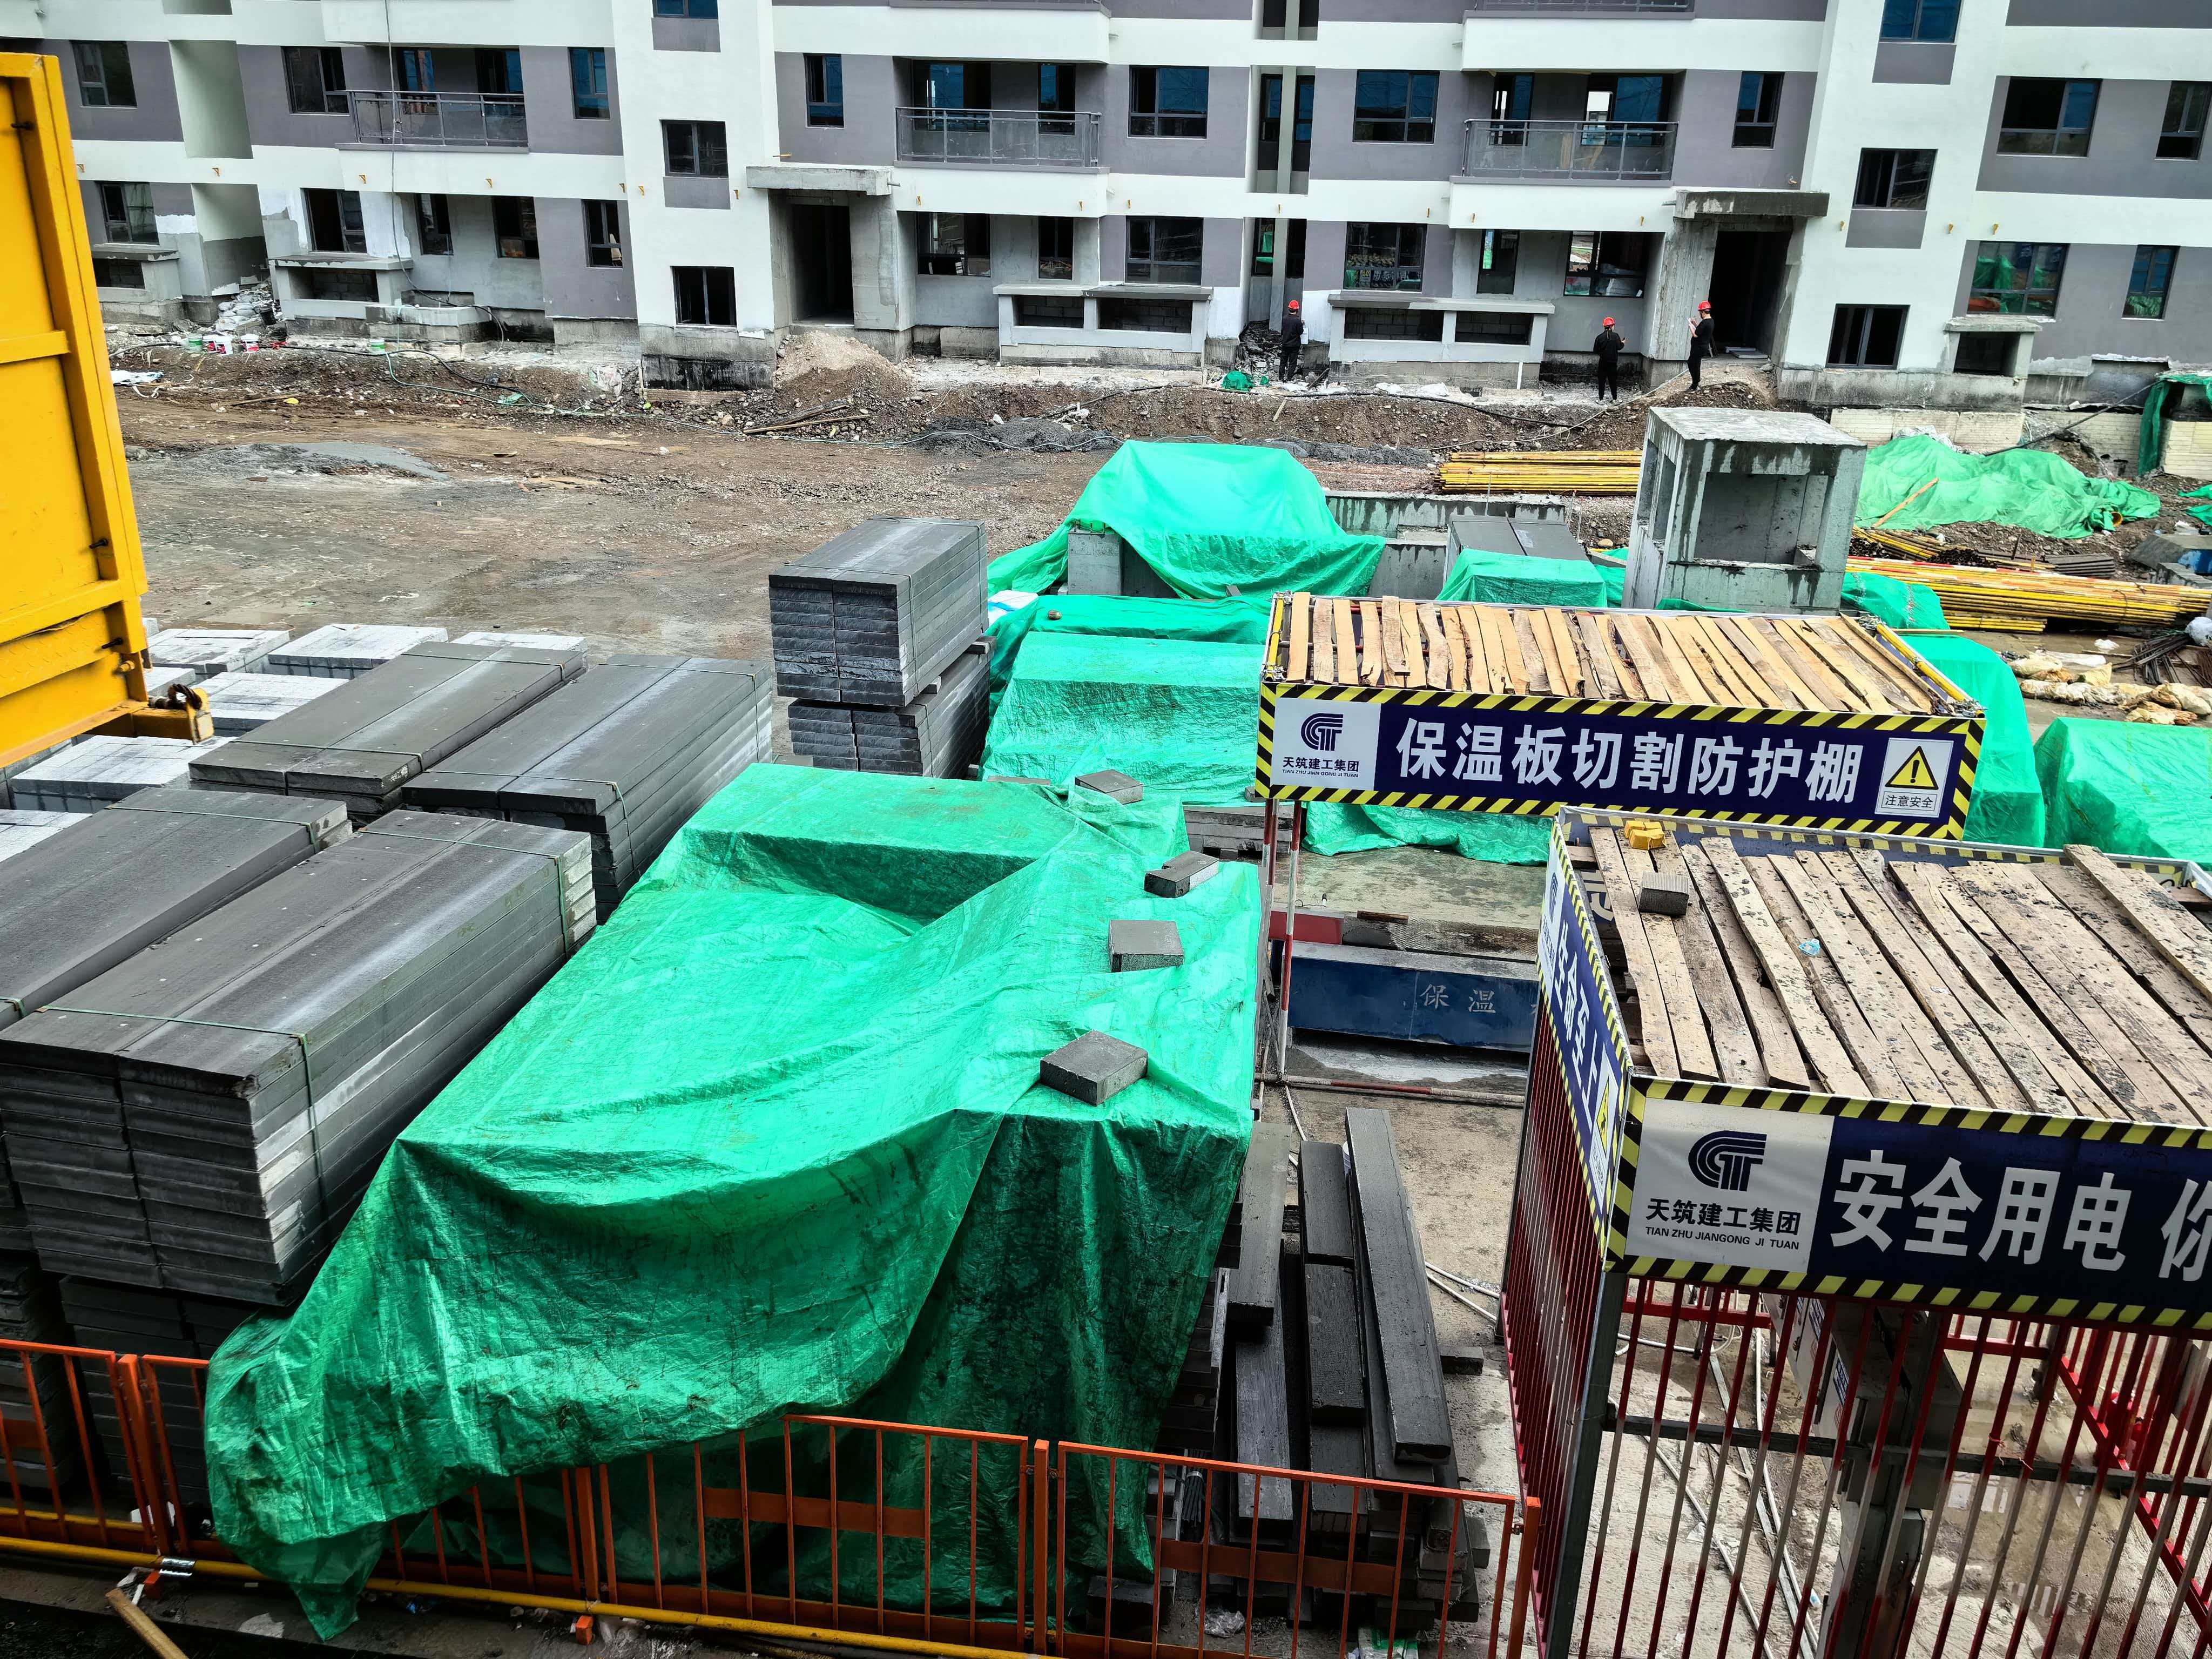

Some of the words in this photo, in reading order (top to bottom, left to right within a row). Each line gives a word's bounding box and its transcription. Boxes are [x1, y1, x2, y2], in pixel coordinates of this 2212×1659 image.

[1283, 757, 1359, 772] 天筑建工集团
[1397, 718, 1863, 803] 保温板切割防护棚
[1885, 795, 1933, 808] 注意安全
[1420, 984, 1538, 1015] 保温
[1645, 1198, 1801, 1235] 天筑建工集团
[1645, 1226, 1669, 1237] TIAN
[1671, 1229, 1692, 1238] ZHU
[1755, 1238, 1764, 1246] JI
[1770, 1239, 1799, 1250] TUAN
